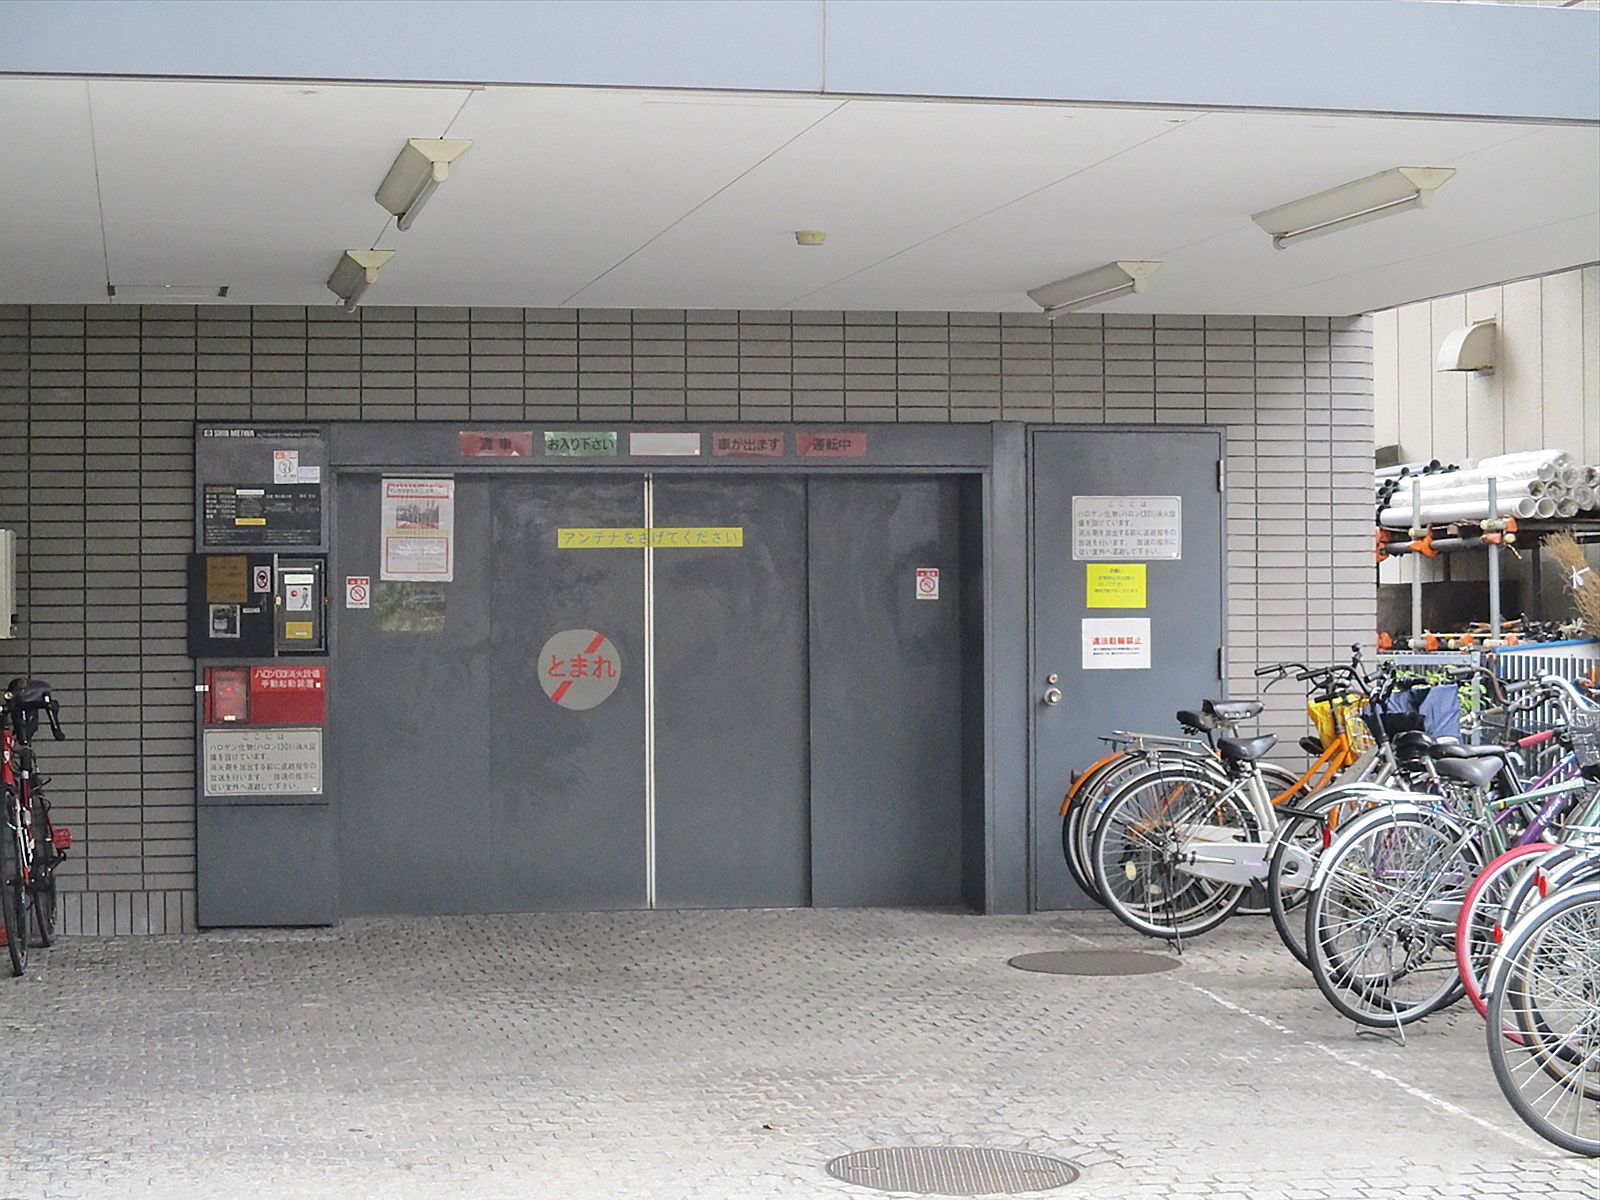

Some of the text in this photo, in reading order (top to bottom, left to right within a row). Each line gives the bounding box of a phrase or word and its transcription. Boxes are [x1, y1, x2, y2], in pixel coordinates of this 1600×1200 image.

[547, 437, 614, 450] お入り下さい
[718, 437, 780, 451] 車が出ます
[811, 437, 852, 451] 運転中
[564, 531, 738, 545] アンテナをさげてください
[548, 655, 617, 678] とまれ
[243, 733, 285, 741] ここには
